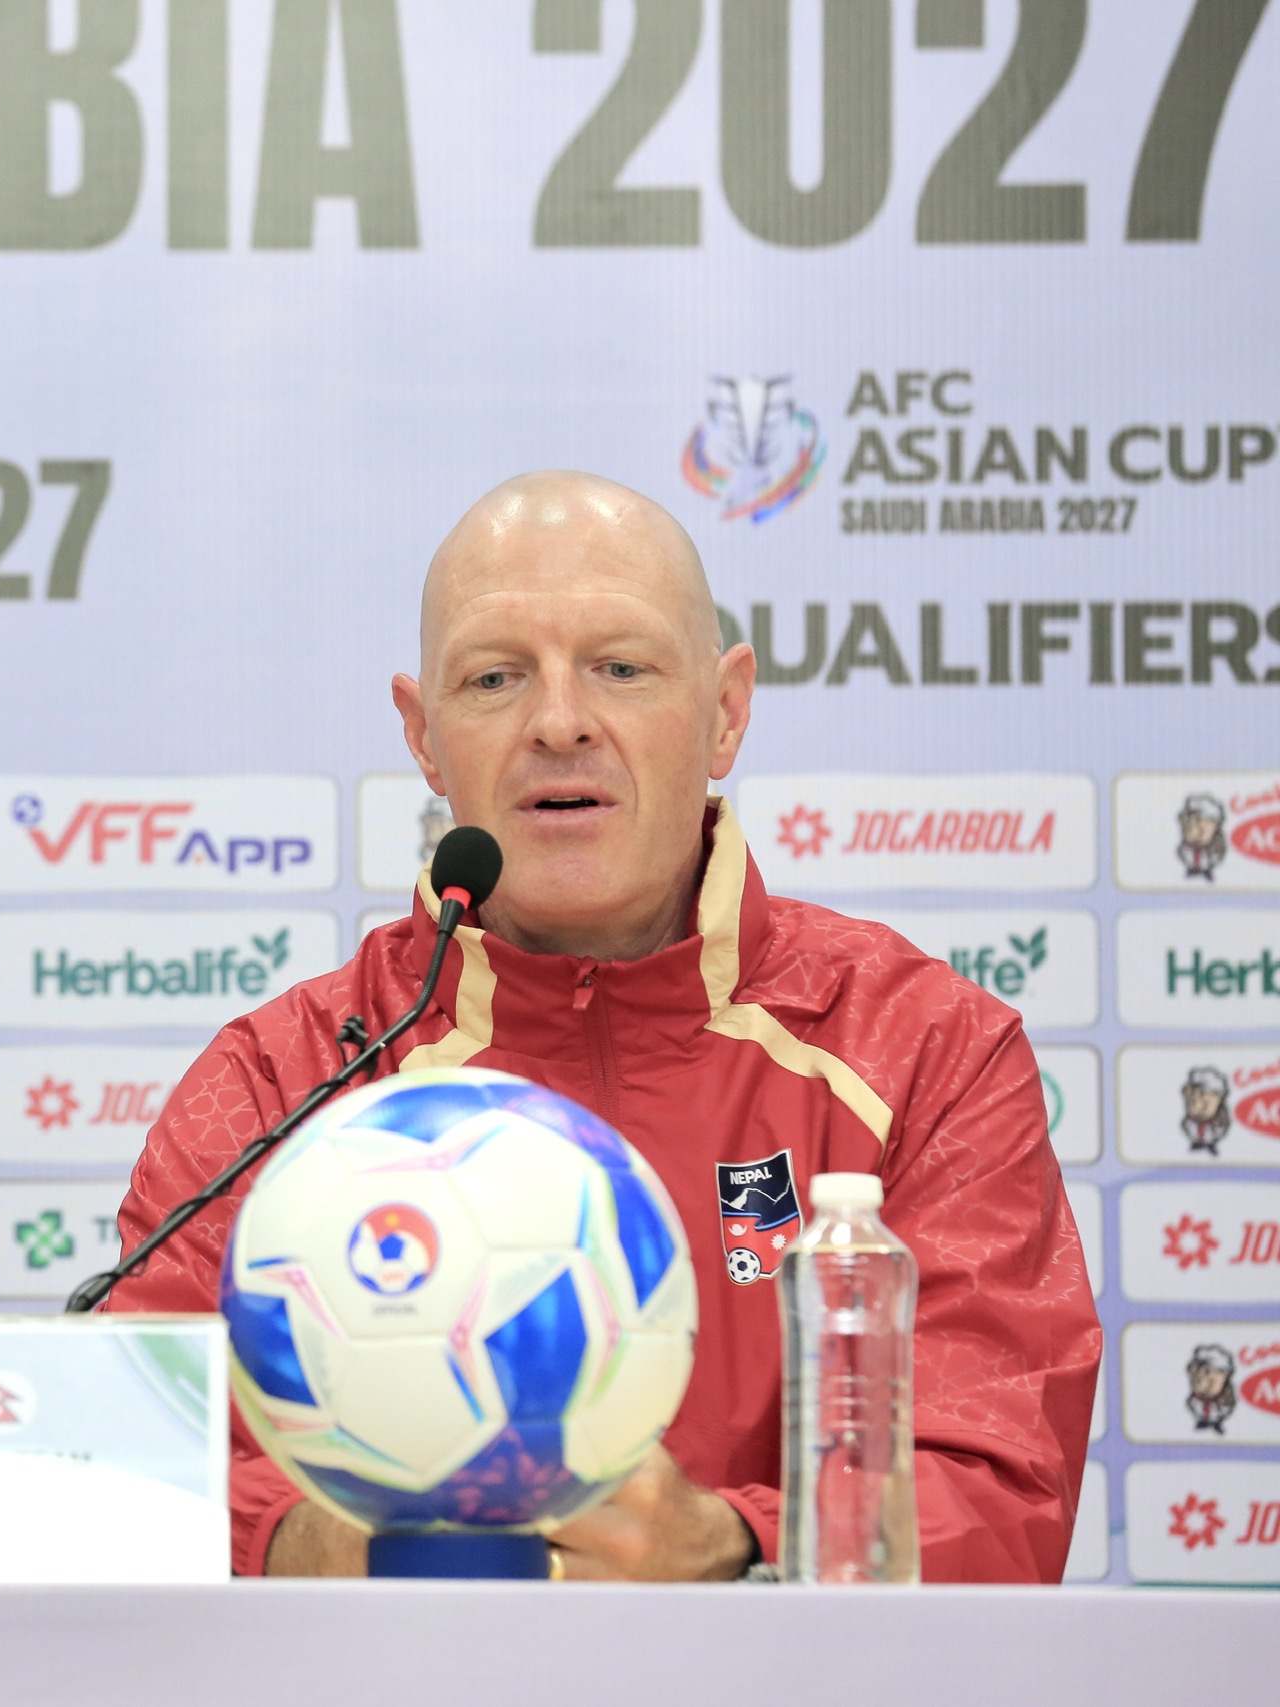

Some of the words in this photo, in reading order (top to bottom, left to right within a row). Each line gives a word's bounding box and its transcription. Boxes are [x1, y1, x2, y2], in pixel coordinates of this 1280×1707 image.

[531, 0, 1273, 249] 2027
[846, 370, 973, 417] AFC
[841, 427, 1089, 484] ASIAN
[1108, 425, 1276, 484] CUP
[840, 498, 928, 534] SAUDI
[938, 498, 1046, 534] ARABIA
[1057, 498, 1138, 534] 2027
[718, 601, 1280, 686] UALIFIER
[842, 810, 1057, 854] JOGARBOLA
[33, 948, 269, 996] Herbalife
[729, 1166, 773, 1185] NEPAL
